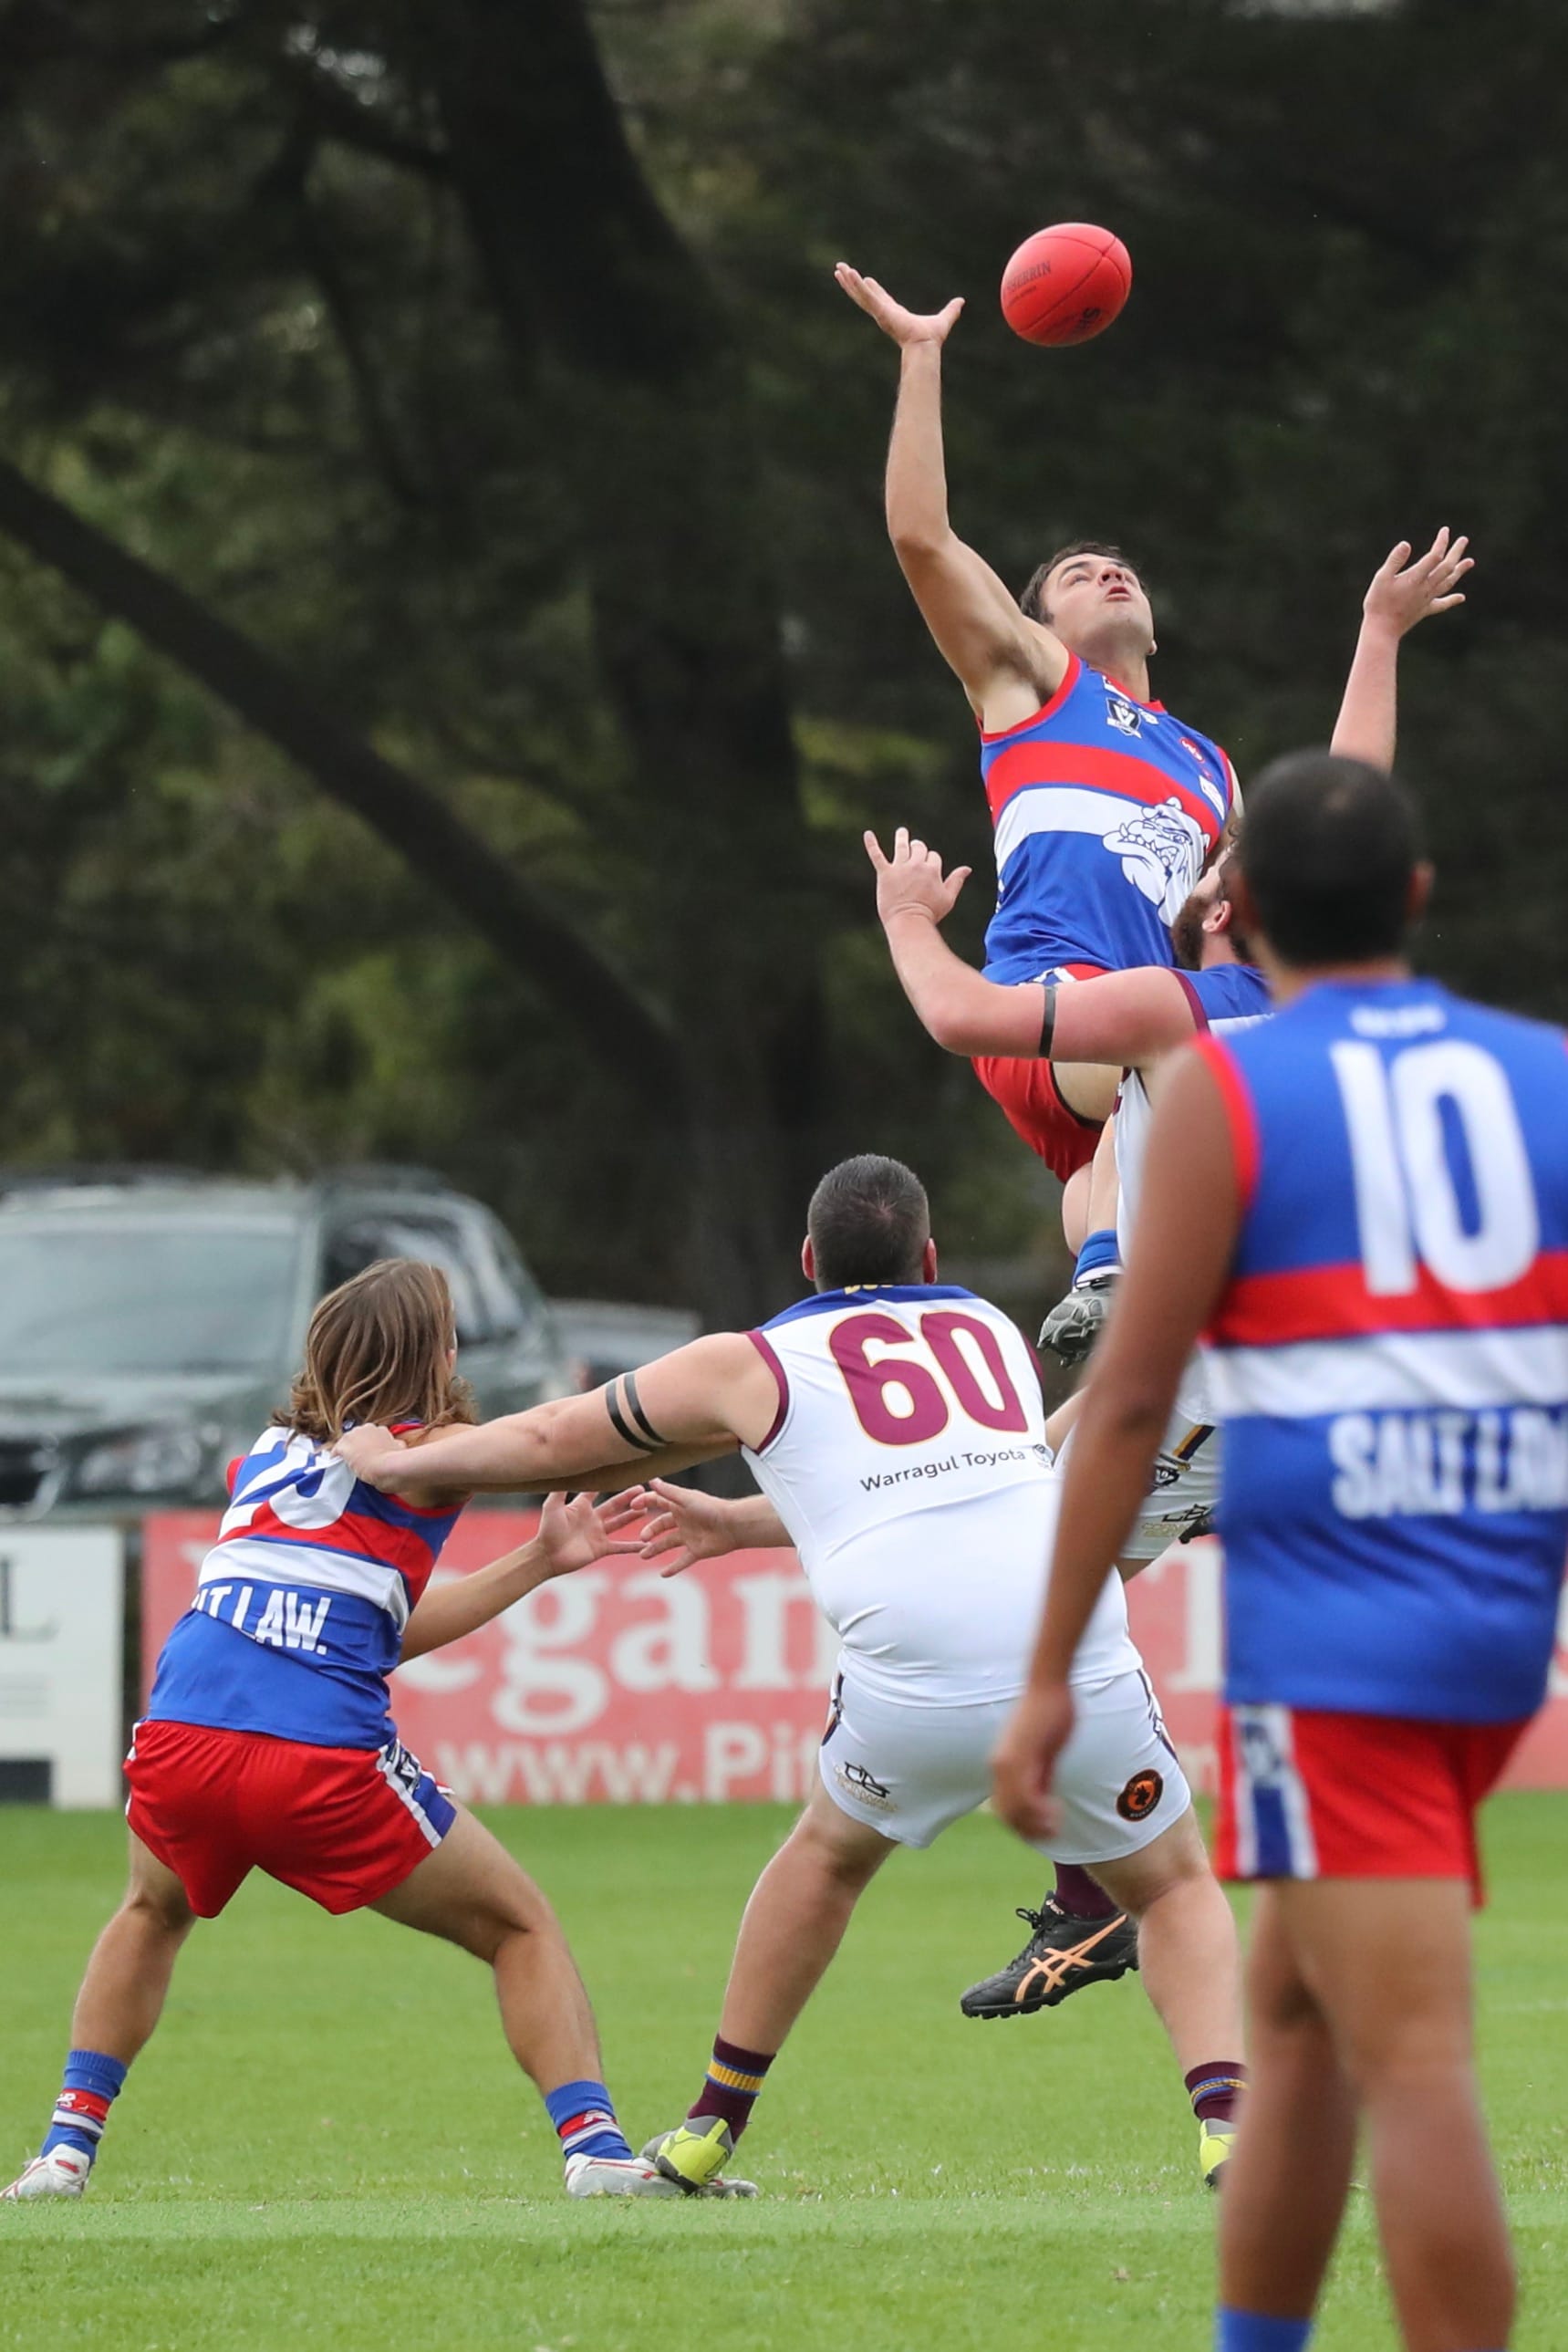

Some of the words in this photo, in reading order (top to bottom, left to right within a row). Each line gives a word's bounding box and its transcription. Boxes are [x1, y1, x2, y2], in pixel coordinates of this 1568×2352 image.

[1330, 1039, 1541, 1296] 10
[827, 1309, 1029, 1448] 60
[860, 1455, 960, 1492] Warragul
[961, 1449, 1026, 1467] Toyota
